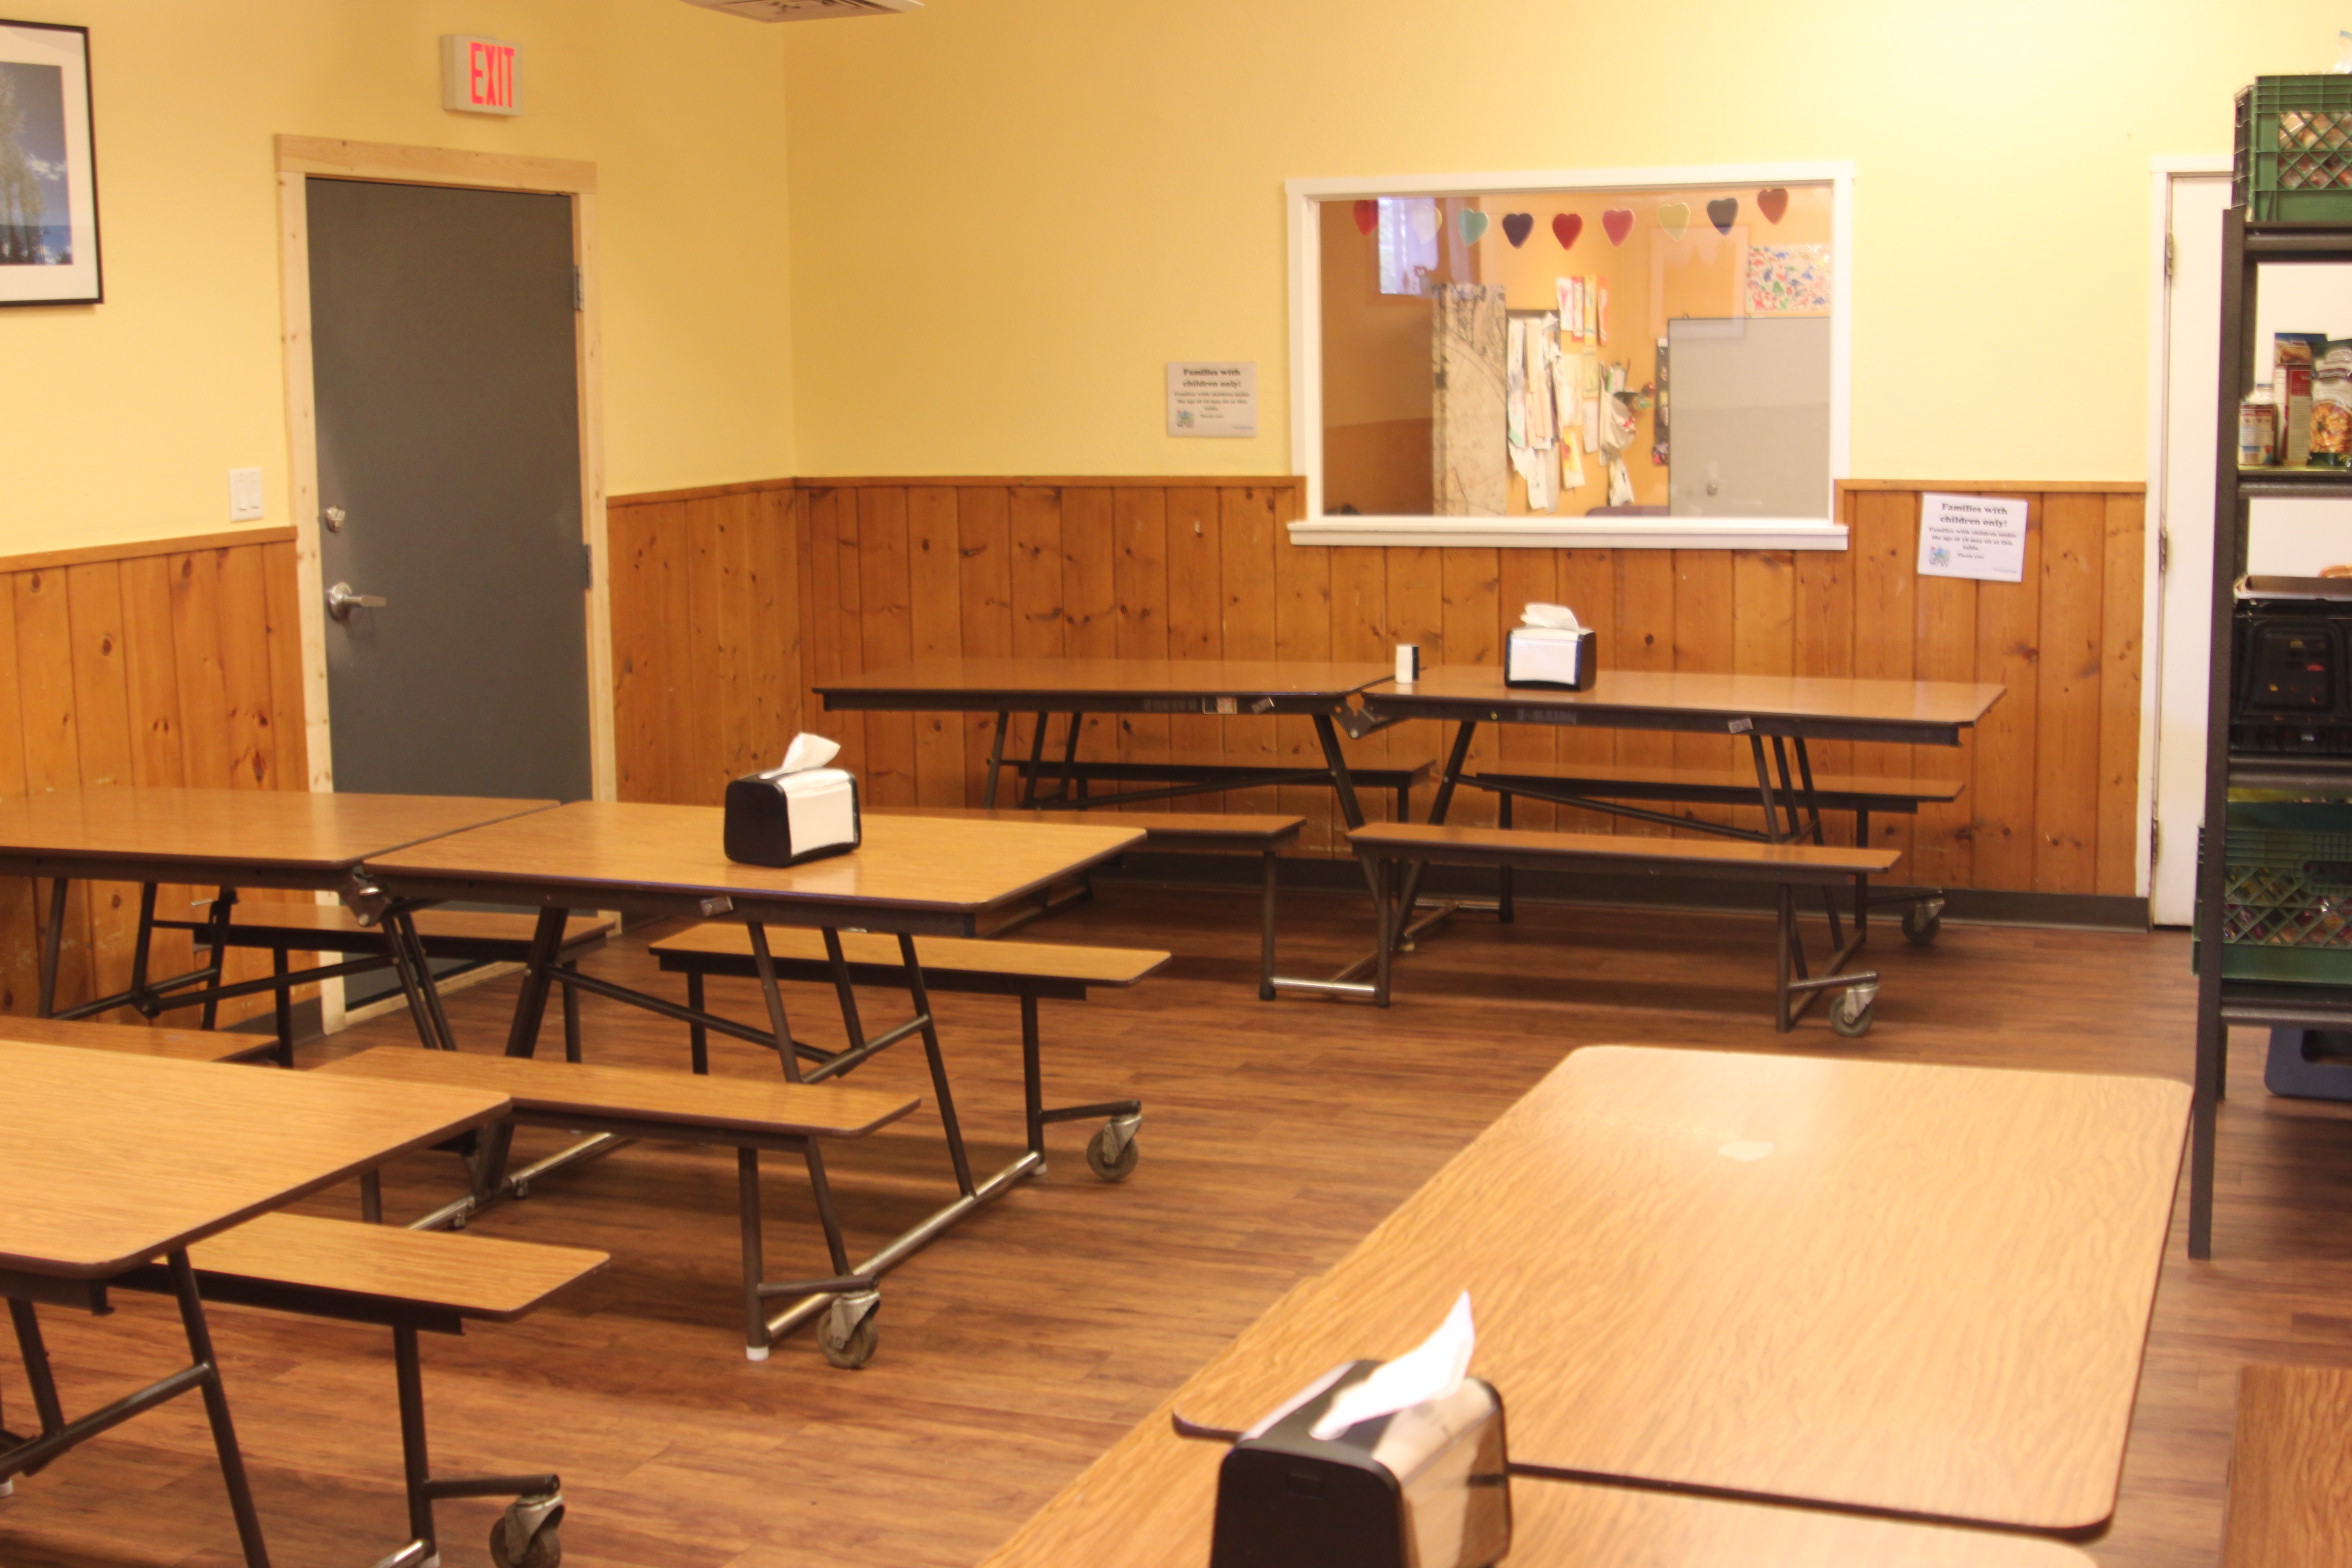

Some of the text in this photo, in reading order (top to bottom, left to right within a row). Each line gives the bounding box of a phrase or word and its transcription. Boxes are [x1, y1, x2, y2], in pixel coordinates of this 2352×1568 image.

[469, 42, 515, 108] EXIT
[1220, 368, 1241, 376] with
[1183, 380, 1241, 389] children only!
[1941, 503, 2008, 515] Families with
[1940, 515, 2008, 528] children only!
